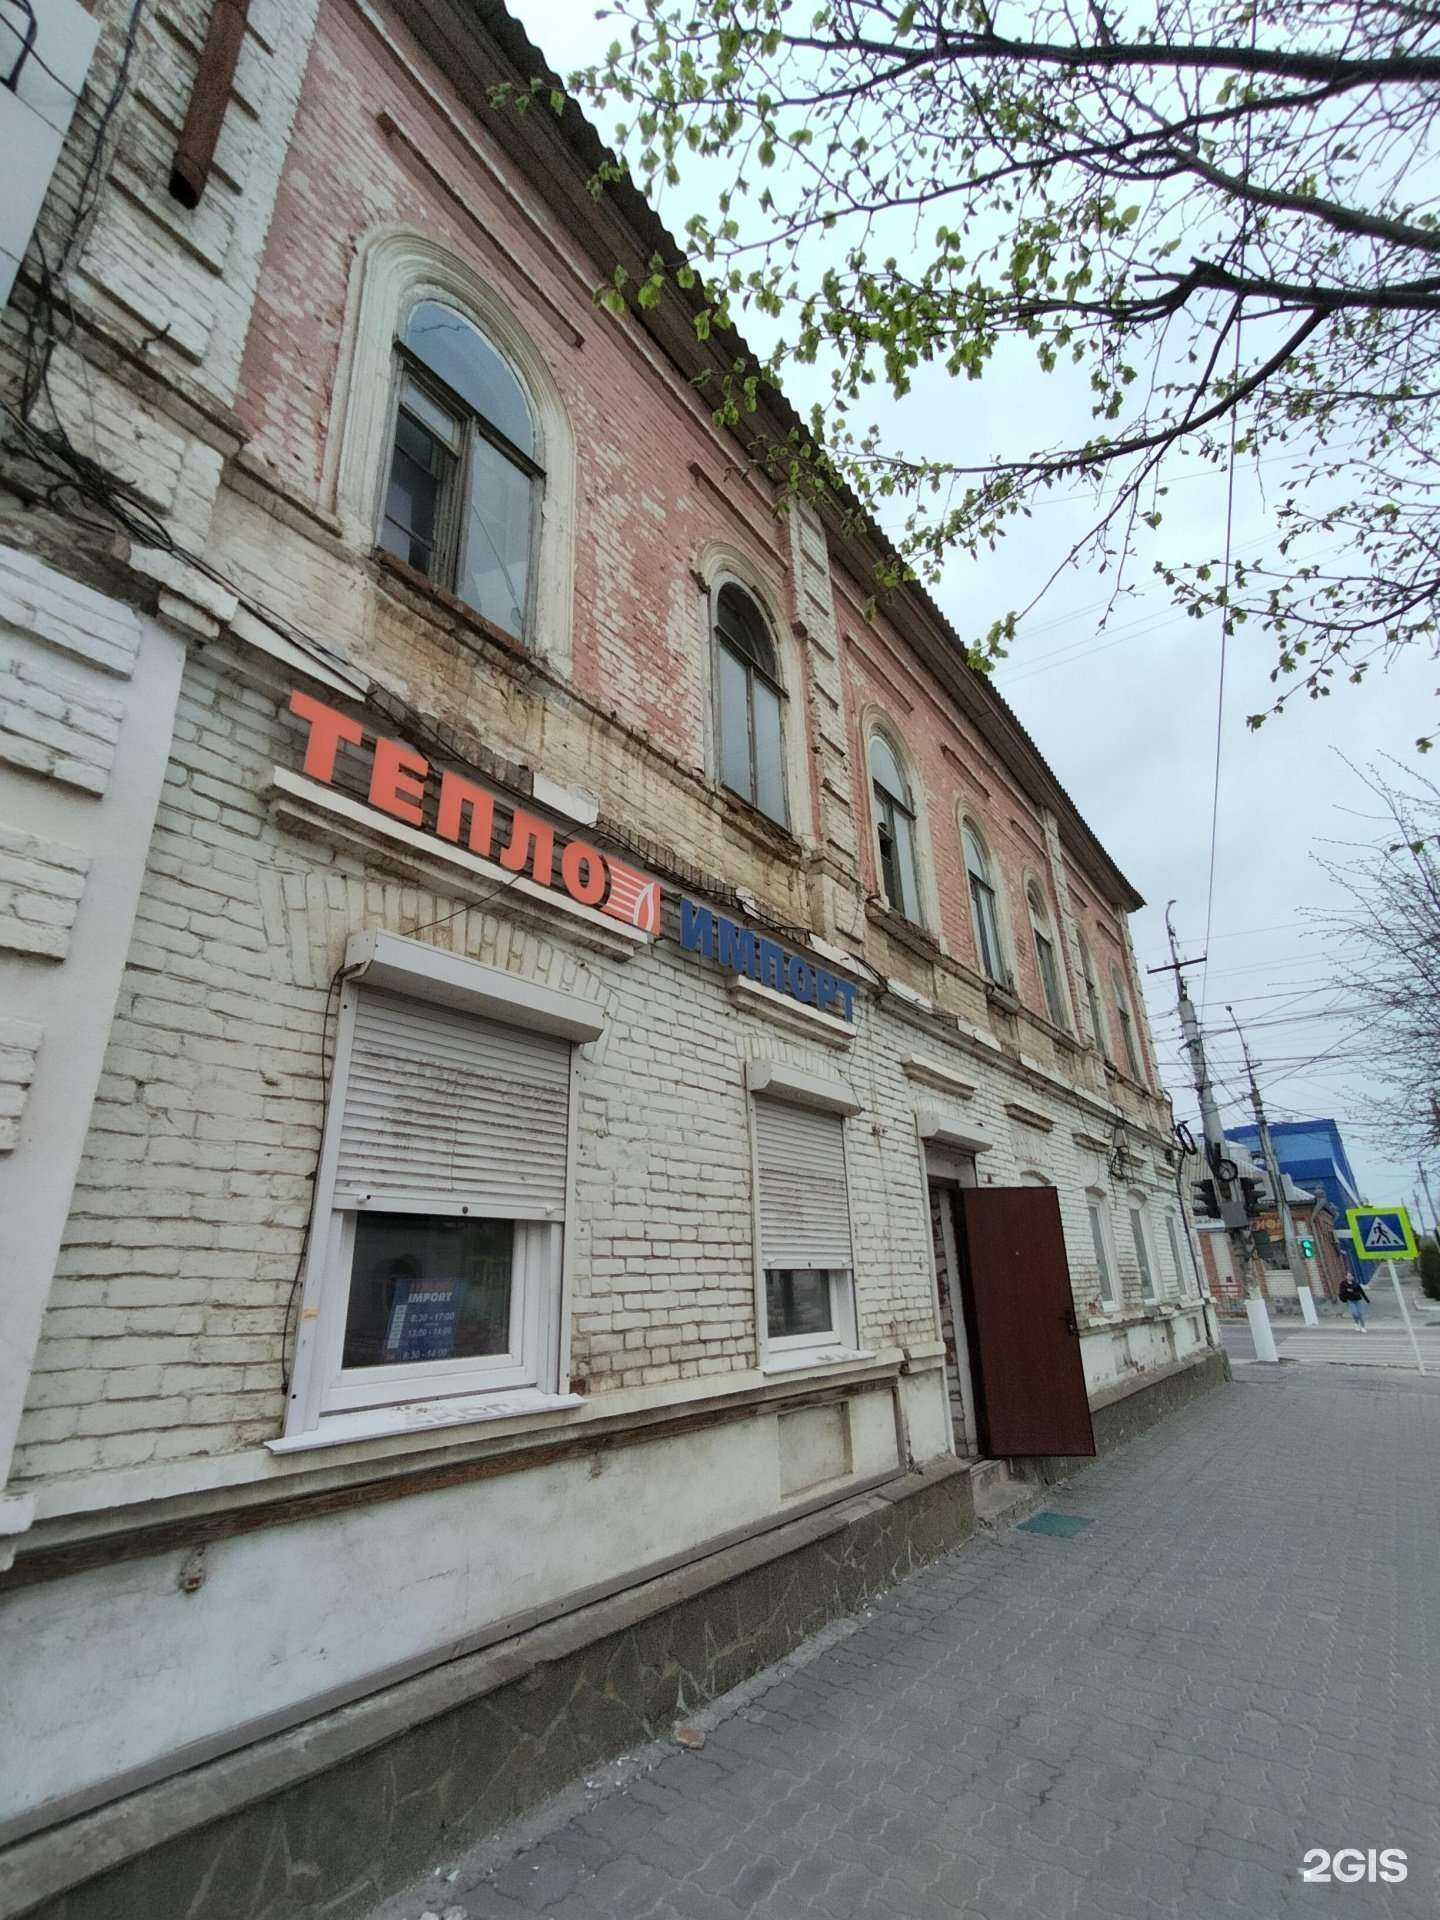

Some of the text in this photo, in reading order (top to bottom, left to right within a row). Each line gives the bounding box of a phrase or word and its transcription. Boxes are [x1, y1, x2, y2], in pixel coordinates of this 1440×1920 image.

[289, 689, 857, 1024] ТЕПЛО ИМПОРТ
[408, 1291, 453, 1304] IMPORT
